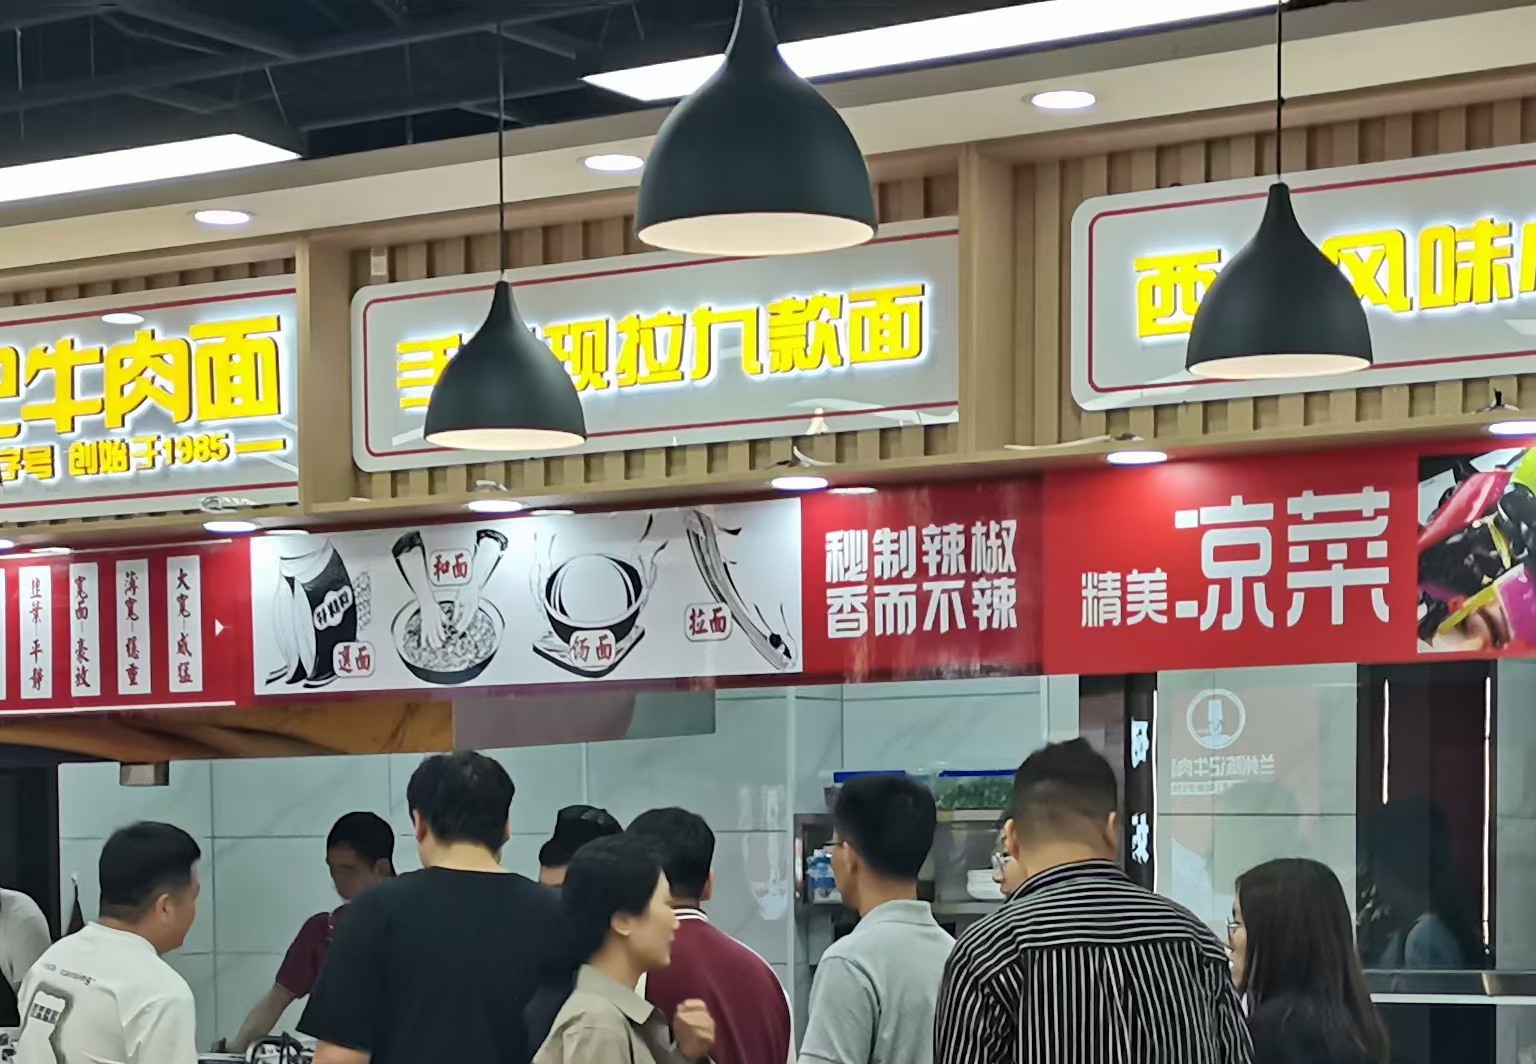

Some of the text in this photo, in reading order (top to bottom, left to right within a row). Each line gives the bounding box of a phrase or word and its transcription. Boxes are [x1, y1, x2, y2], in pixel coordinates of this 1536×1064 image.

[396, 282, 928, 409] 手现拉九款面
[432, 553, 468, 581] 和面
[825, 518, 1019, 583] 秘制辣椒
[1080, 485, 1392, 631] 精美 凉菜
[688, 607, 726, 636] 拉面
[825, 575, 1018, 641] 香而不辣
